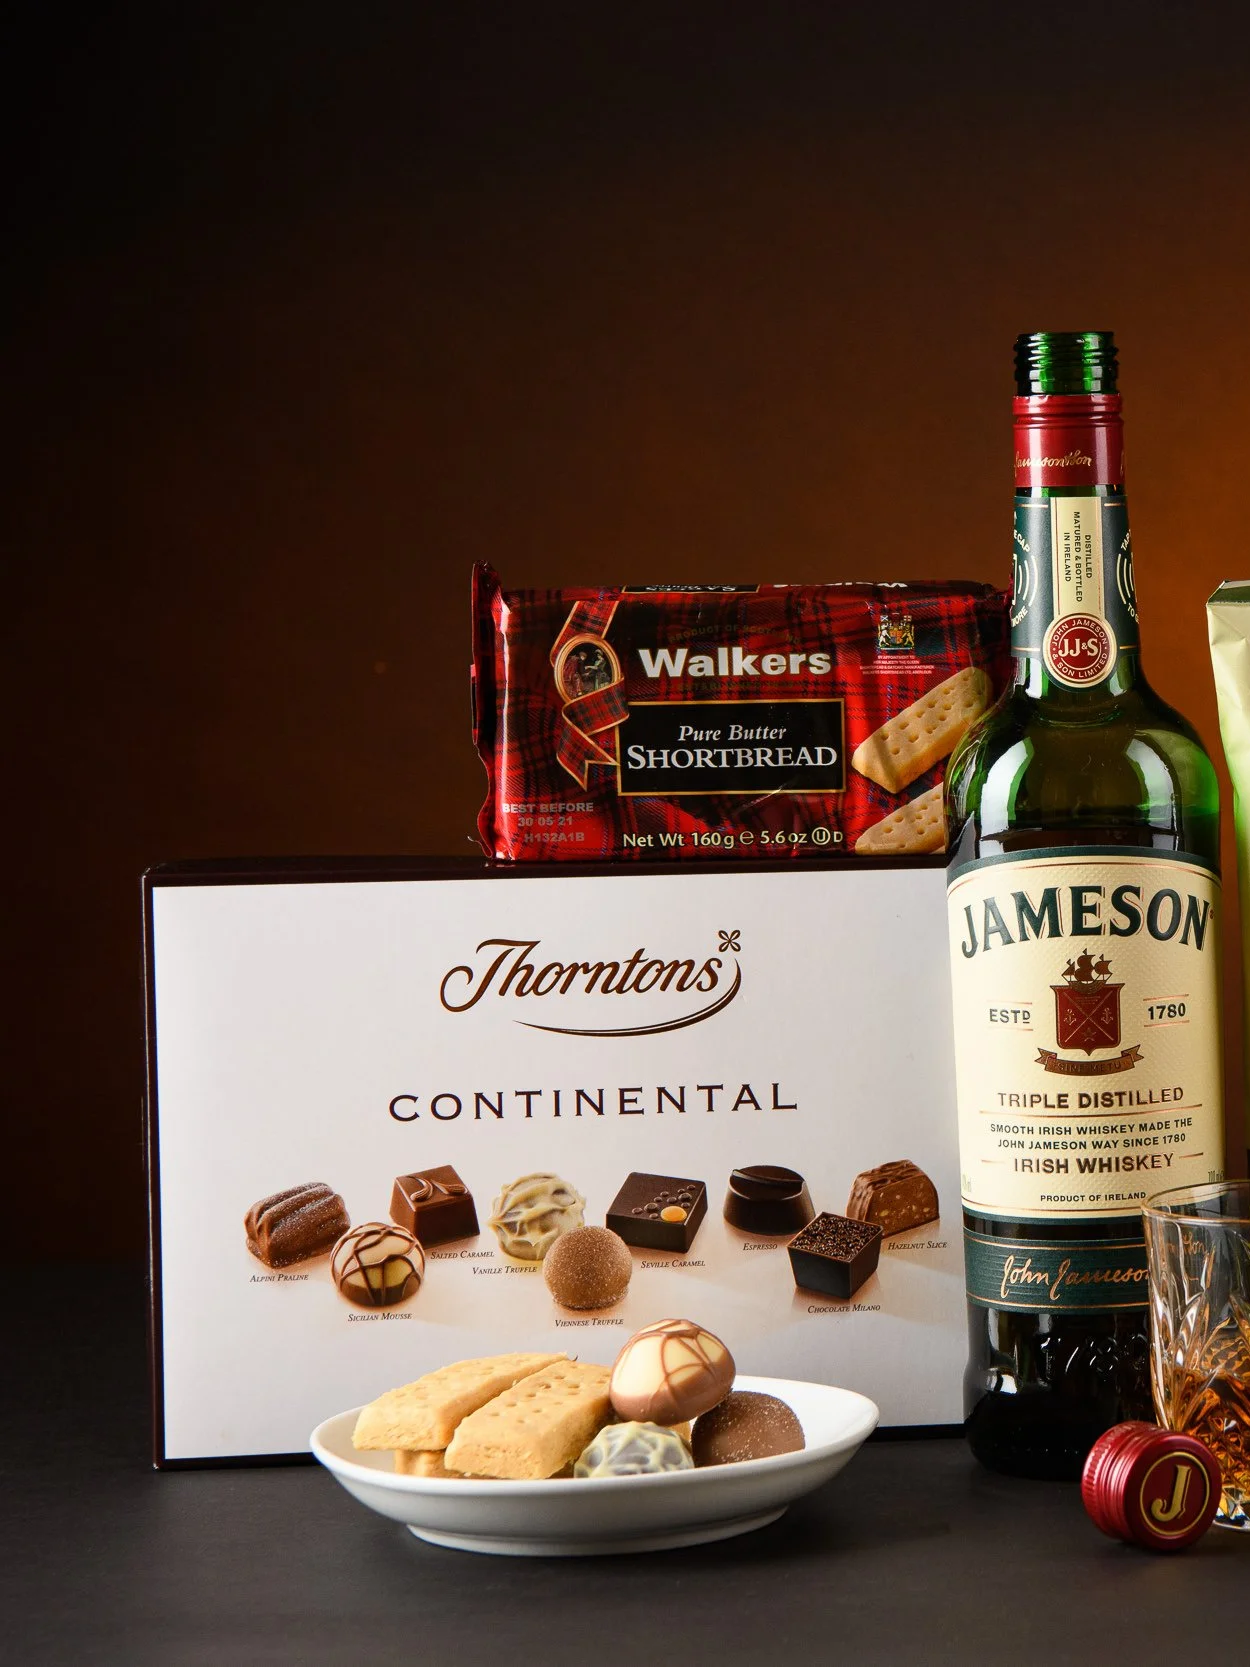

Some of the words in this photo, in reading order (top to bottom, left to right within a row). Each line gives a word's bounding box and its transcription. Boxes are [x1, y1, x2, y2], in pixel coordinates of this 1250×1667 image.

[1064, 532, 1070, 542] IN
[1085, 534, 1093, 579] DISTILLED
[1052, 623, 1069, 646] JOHN
[1072, 619, 1108, 646] JAMESON
[638, 647, 832, 678] Walkers
[1057, 661, 1075, 678] SON
[1078, 652, 1108, 678] LIMITED
[678, 726, 721, 742] Pure
[728, 725, 787, 741] Butter
[627, 745, 838, 769] SHORTBREAD
[503, 803, 536, 813] BEST
[540, 802, 594, 813] BEFORE
[518, 817, 533, 826] 30
[538, 817, 554, 826] 05
[558, 816, 573, 826] 21
[623, 833, 654, 847] Net
[659, 832, 684, 847] Wt
[961, 885, 1211, 959] JAMESON
[441, 938, 722, 1013] Thorntons
[1147, 1002, 1187, 1021] 1780
[389, 1082, 798, 1123] CONTINENTAL
[997, 1092, 1069, 1109] TRIPLE
[1078, 1086, 1184, 1109] DISTILLED
[990, 1123, 1034, 1135] SMOOTH
[1039, 1126, 1072, 1136] IRISH
[1076, 1123, 1135, 1136] WHISKEY
[1138, 1120, 1171, 1132] MADE
[1174, 1117, 1193, 1129] THE
[998, 1138, 1025, 1149] JOHN
[1028, 1140, 1087, 1150] JAMESON
[1091, 1139, 1118, 1150] WAY
[1123, 1136, 1159, 1148] SINCE
[1163, 1133, 1186, 1146] 1780
[1014, 1158, 1069, 1173] IRISH
[1076, 1153, 1175, 1174] WHISKEY
[1040, 1194, 1086, 1203] PRODUCT
[1089, 1194, 1102, 1202] OF
[1104, 1191, 1147, 1201] IRELAND
[743, 1242, 778, 1251] ESPRESSO
[887, 1241, 925, 1250] HAZELNUT
[927, 1240, 947, 1249] SLICE
[430, 1251, 458, 1260] SALTED
[460, 1250, 495, 1259] CARAMEL
[472, 1266, 502, 1275] VANILLE
[504, 1265, 538, 1274] TRUFFLE
[640, 1260, 670, 1269] SEVILLE
[671, 1259, 705, 1268] CARAMEL
[250, 1274, 275, 1283] ALPINI
[277, 1273, 309, 1282] PRALINE
[1000, 1254, 1049, 1298] John
[348, 1313, 379, 1322] SICILIAN
[381, 1312, 412, 1320] MOUSSE
[807, 1304, 850, 1314] CHOCOLATE
[852, 1303, 881, 1312] MILANO
[554, 1318, 589, 1328] VIENNESE
[591, 1317, 624, 1326] TRUFFLE
[1151, 1465, 1192, 1521] J
